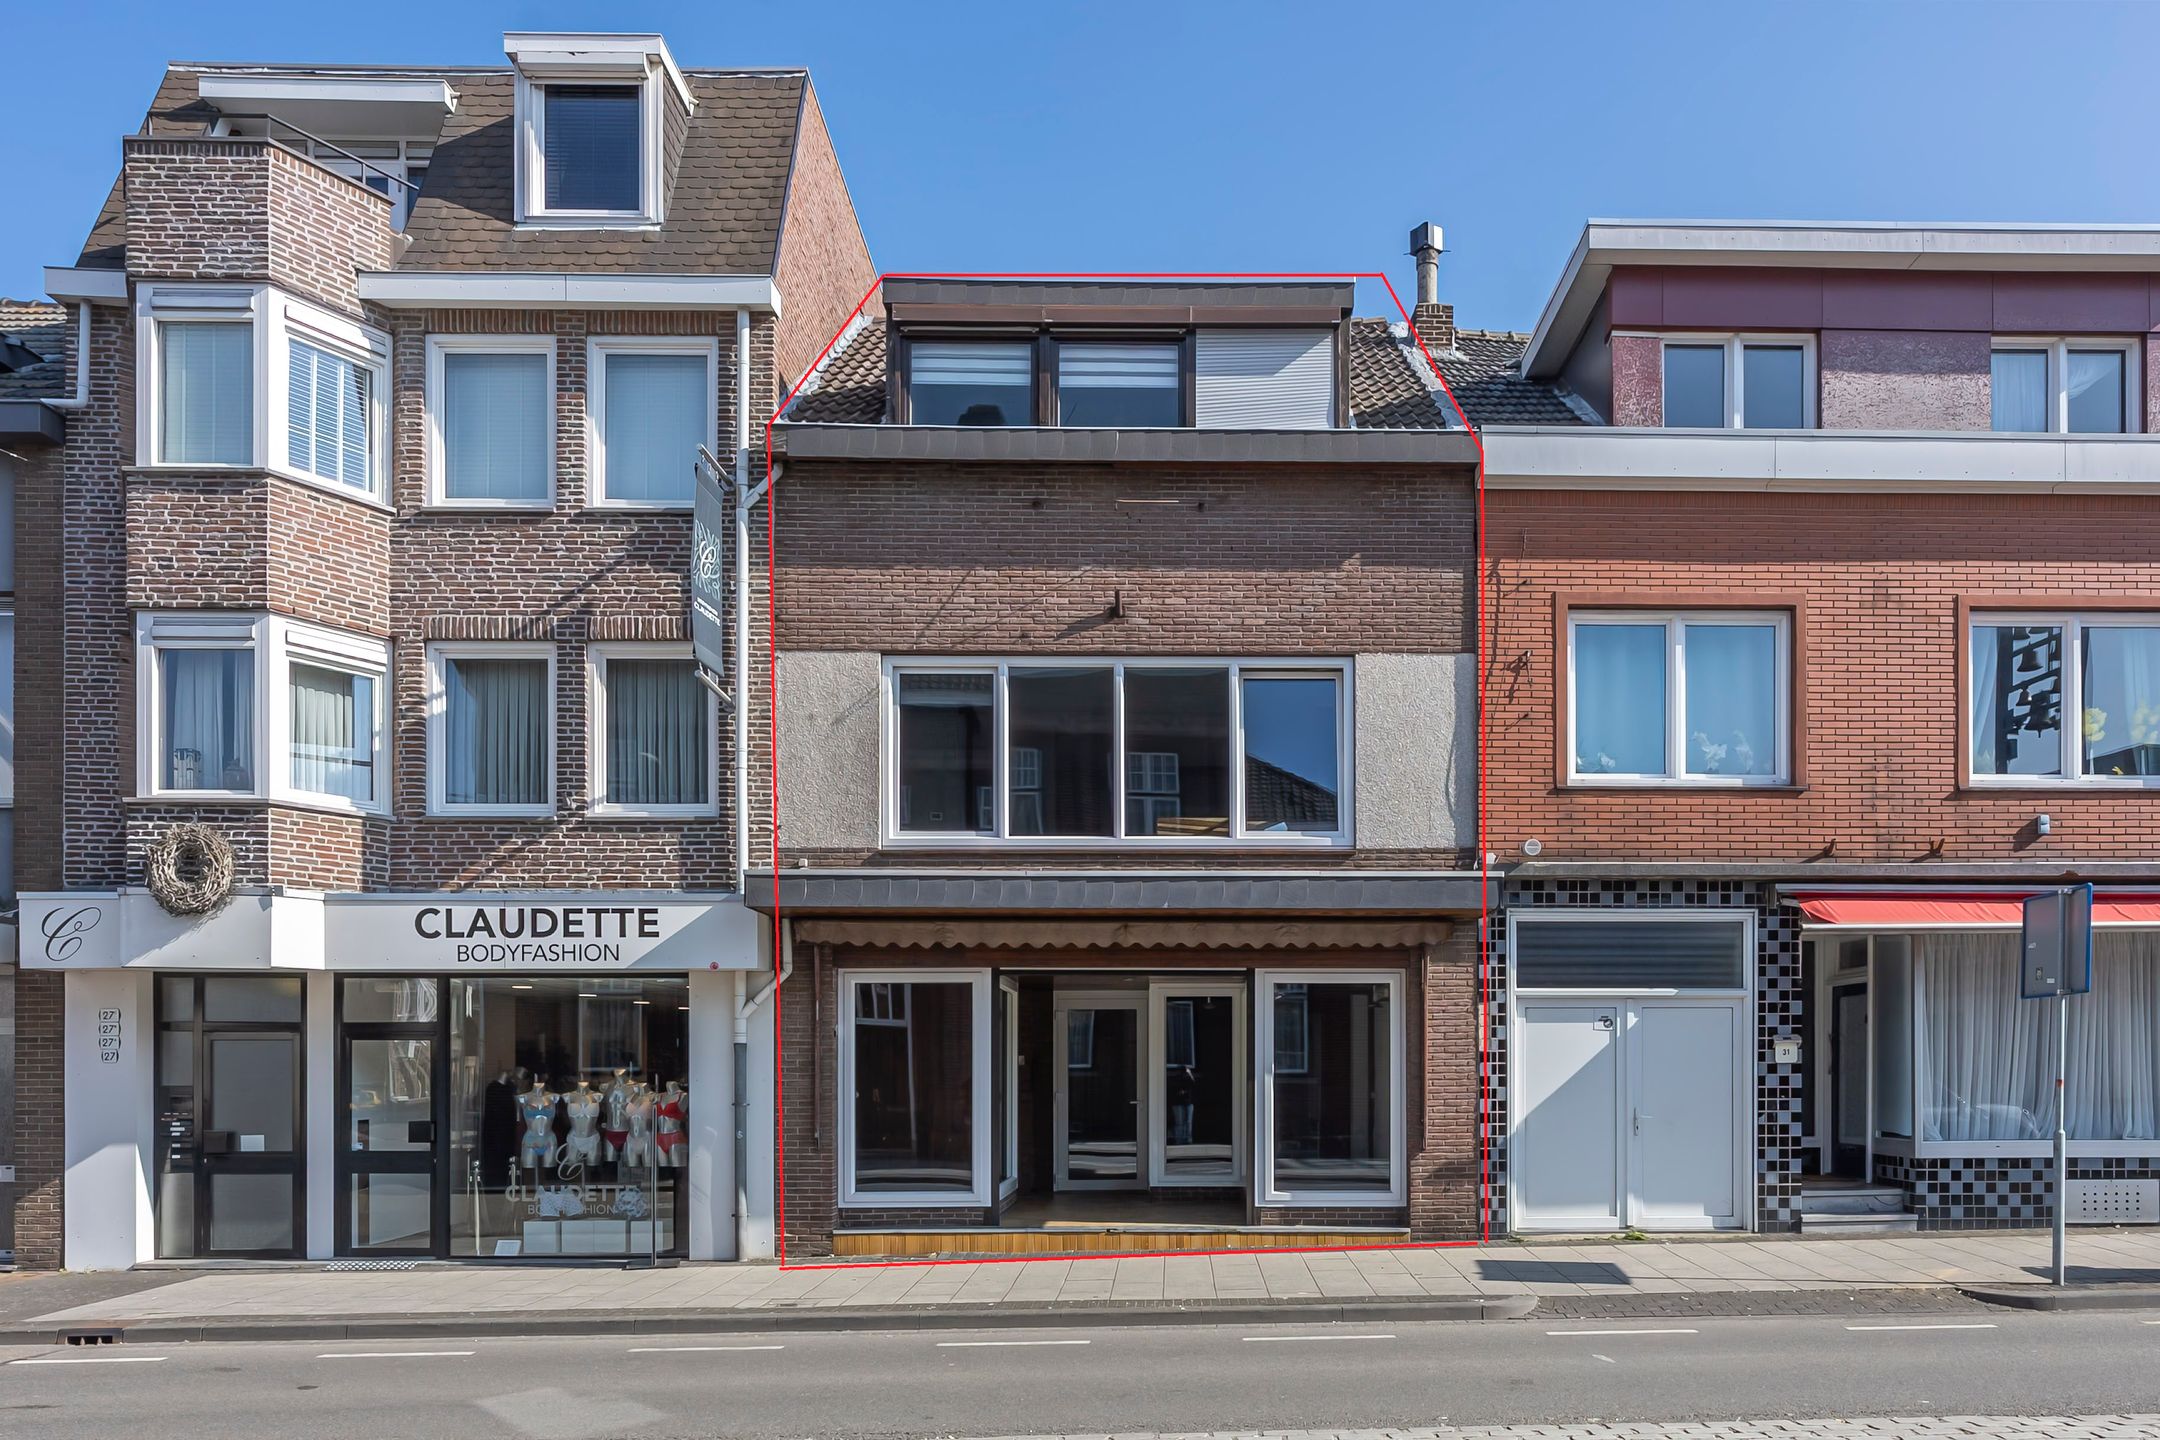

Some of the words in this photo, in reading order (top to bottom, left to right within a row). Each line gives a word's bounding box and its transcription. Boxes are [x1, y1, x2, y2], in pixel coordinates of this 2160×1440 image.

[414, 908, 660, 939] CLAUDETTE
[457, 943, 620, 962] BODYFASHION
[104, 1051, 116, 1061] 27
[1782, 1048, 1790, 1056] 31
[527, 1204, 616, 1215] BOHION
